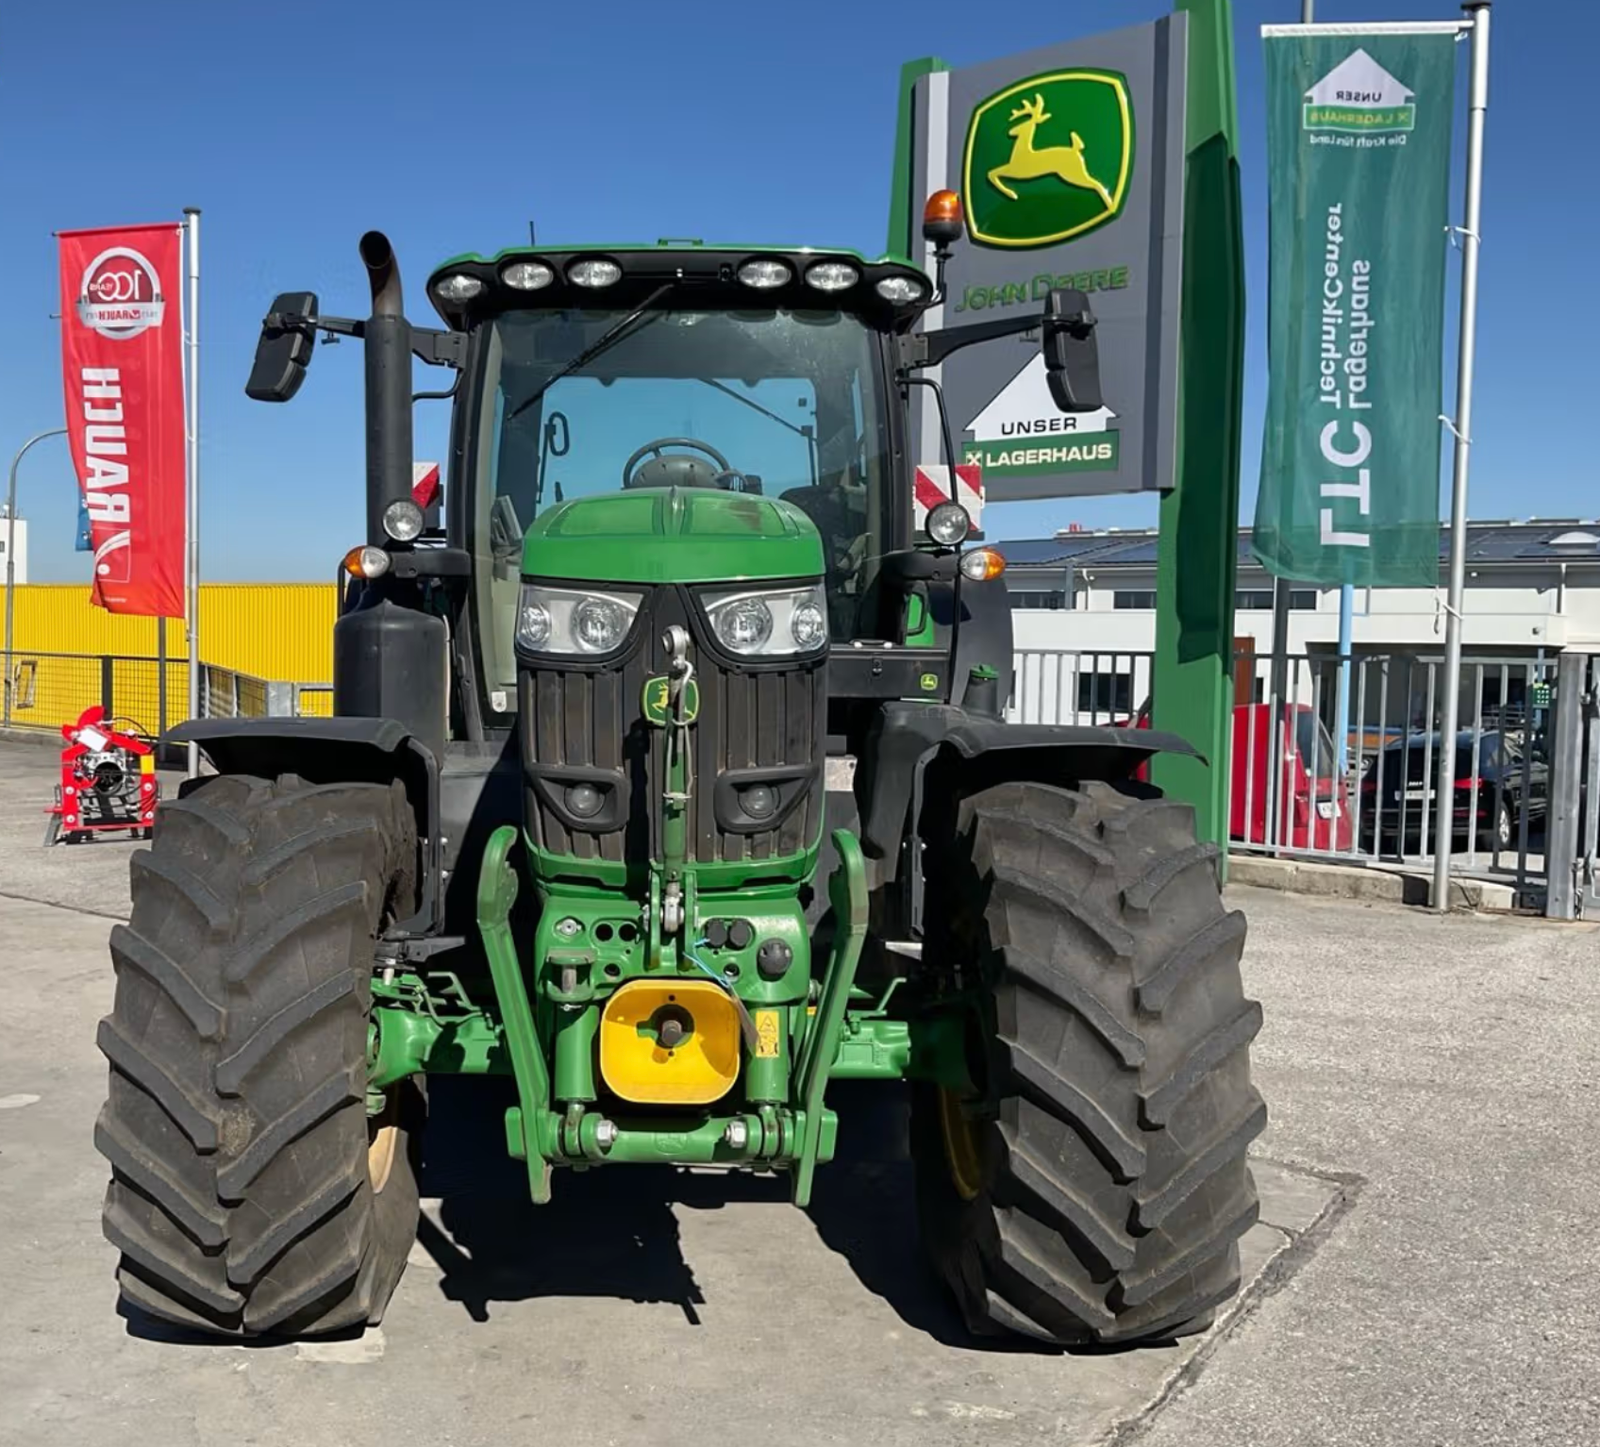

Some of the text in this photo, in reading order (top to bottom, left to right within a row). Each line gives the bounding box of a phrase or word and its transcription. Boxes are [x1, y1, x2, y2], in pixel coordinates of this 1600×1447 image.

[954, 266, 1128, 313] JOHN DEERE
[1001, 417, 1077, 435] UNSER
[986, 443, 1112, 467] LAGERHAUS
